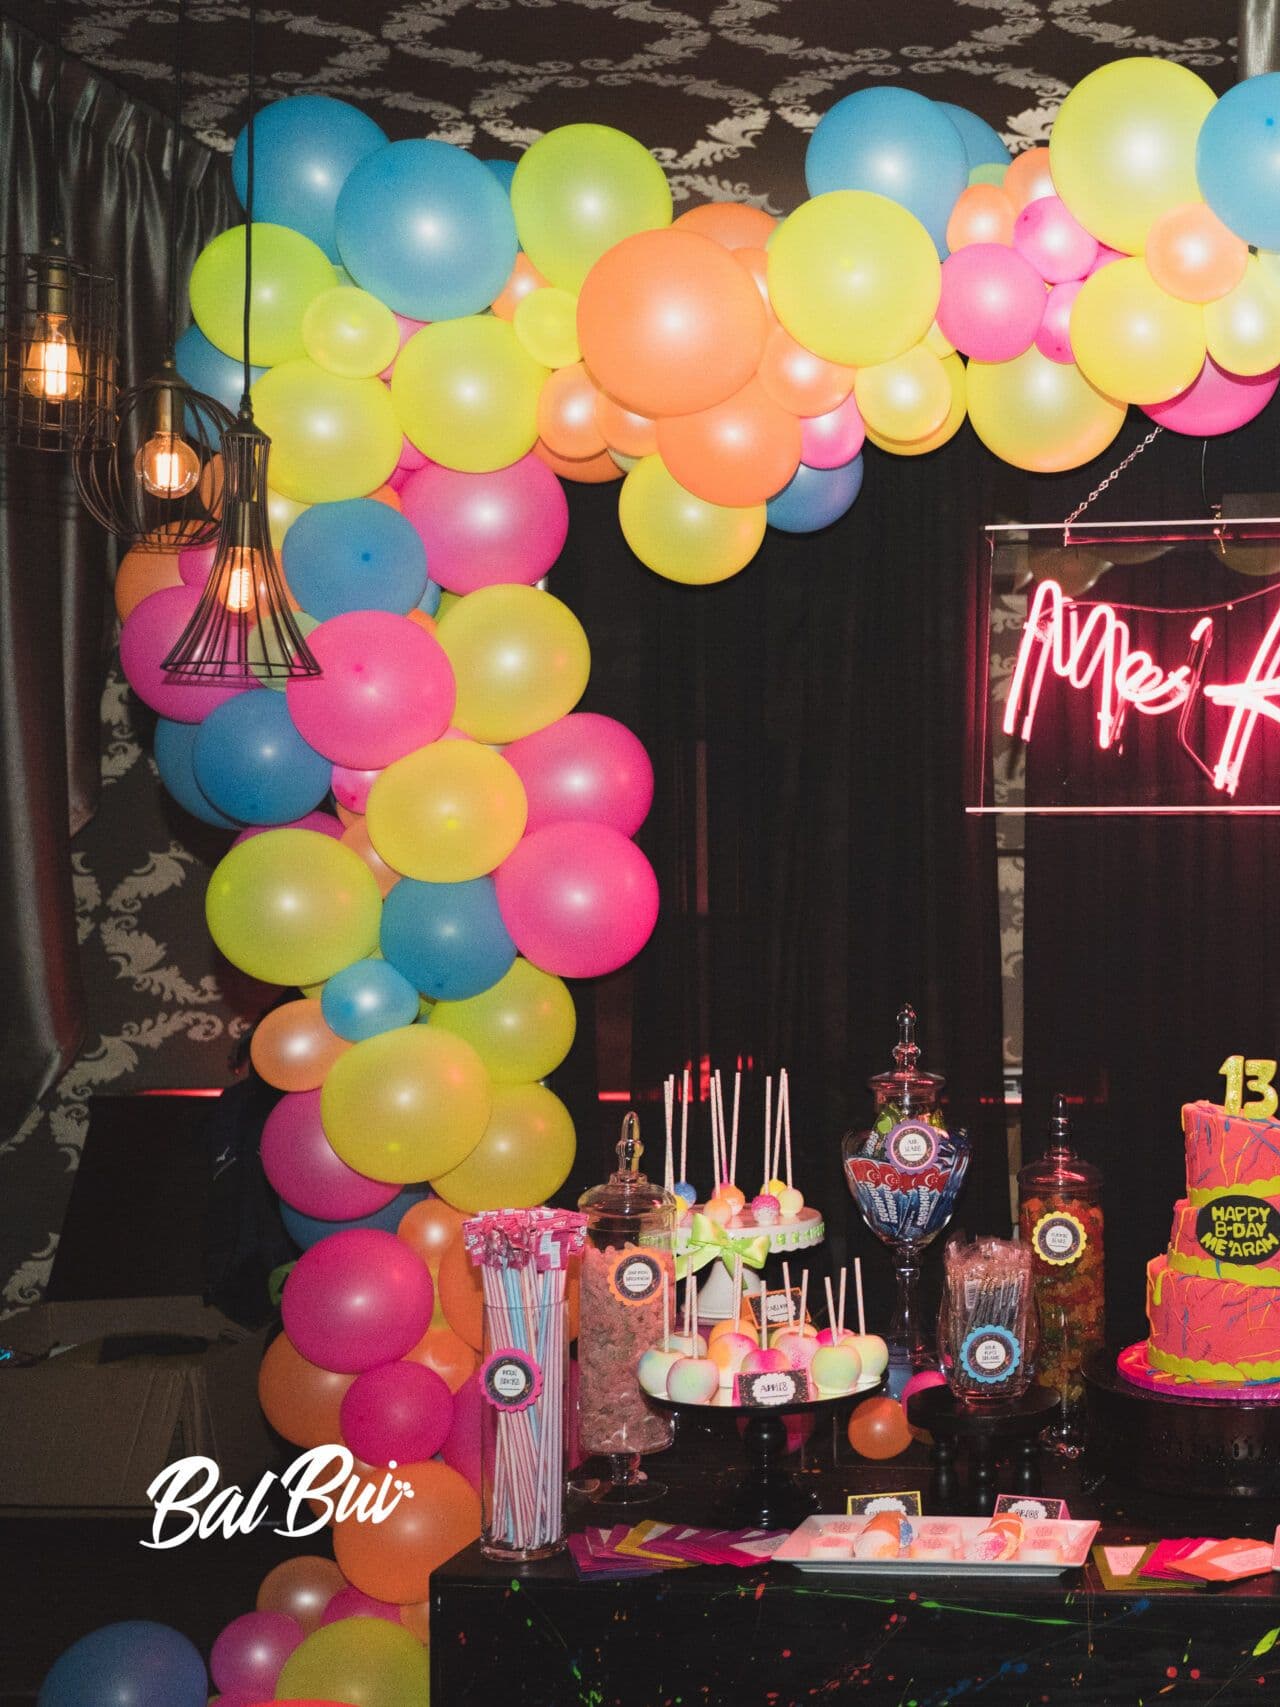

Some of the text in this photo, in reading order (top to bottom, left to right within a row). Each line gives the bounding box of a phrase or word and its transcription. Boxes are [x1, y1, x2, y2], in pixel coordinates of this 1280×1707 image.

[1218, 1055, 1279, 1119] 13
[917, 1185, 930, 1226] AIRHEADS
[1211, 1206, 1271, 1222] HAPPY
[1215, 1222, 1268, 1239] B-DAY
[1200, 1232, 1280, 1257] ME'ARAH
